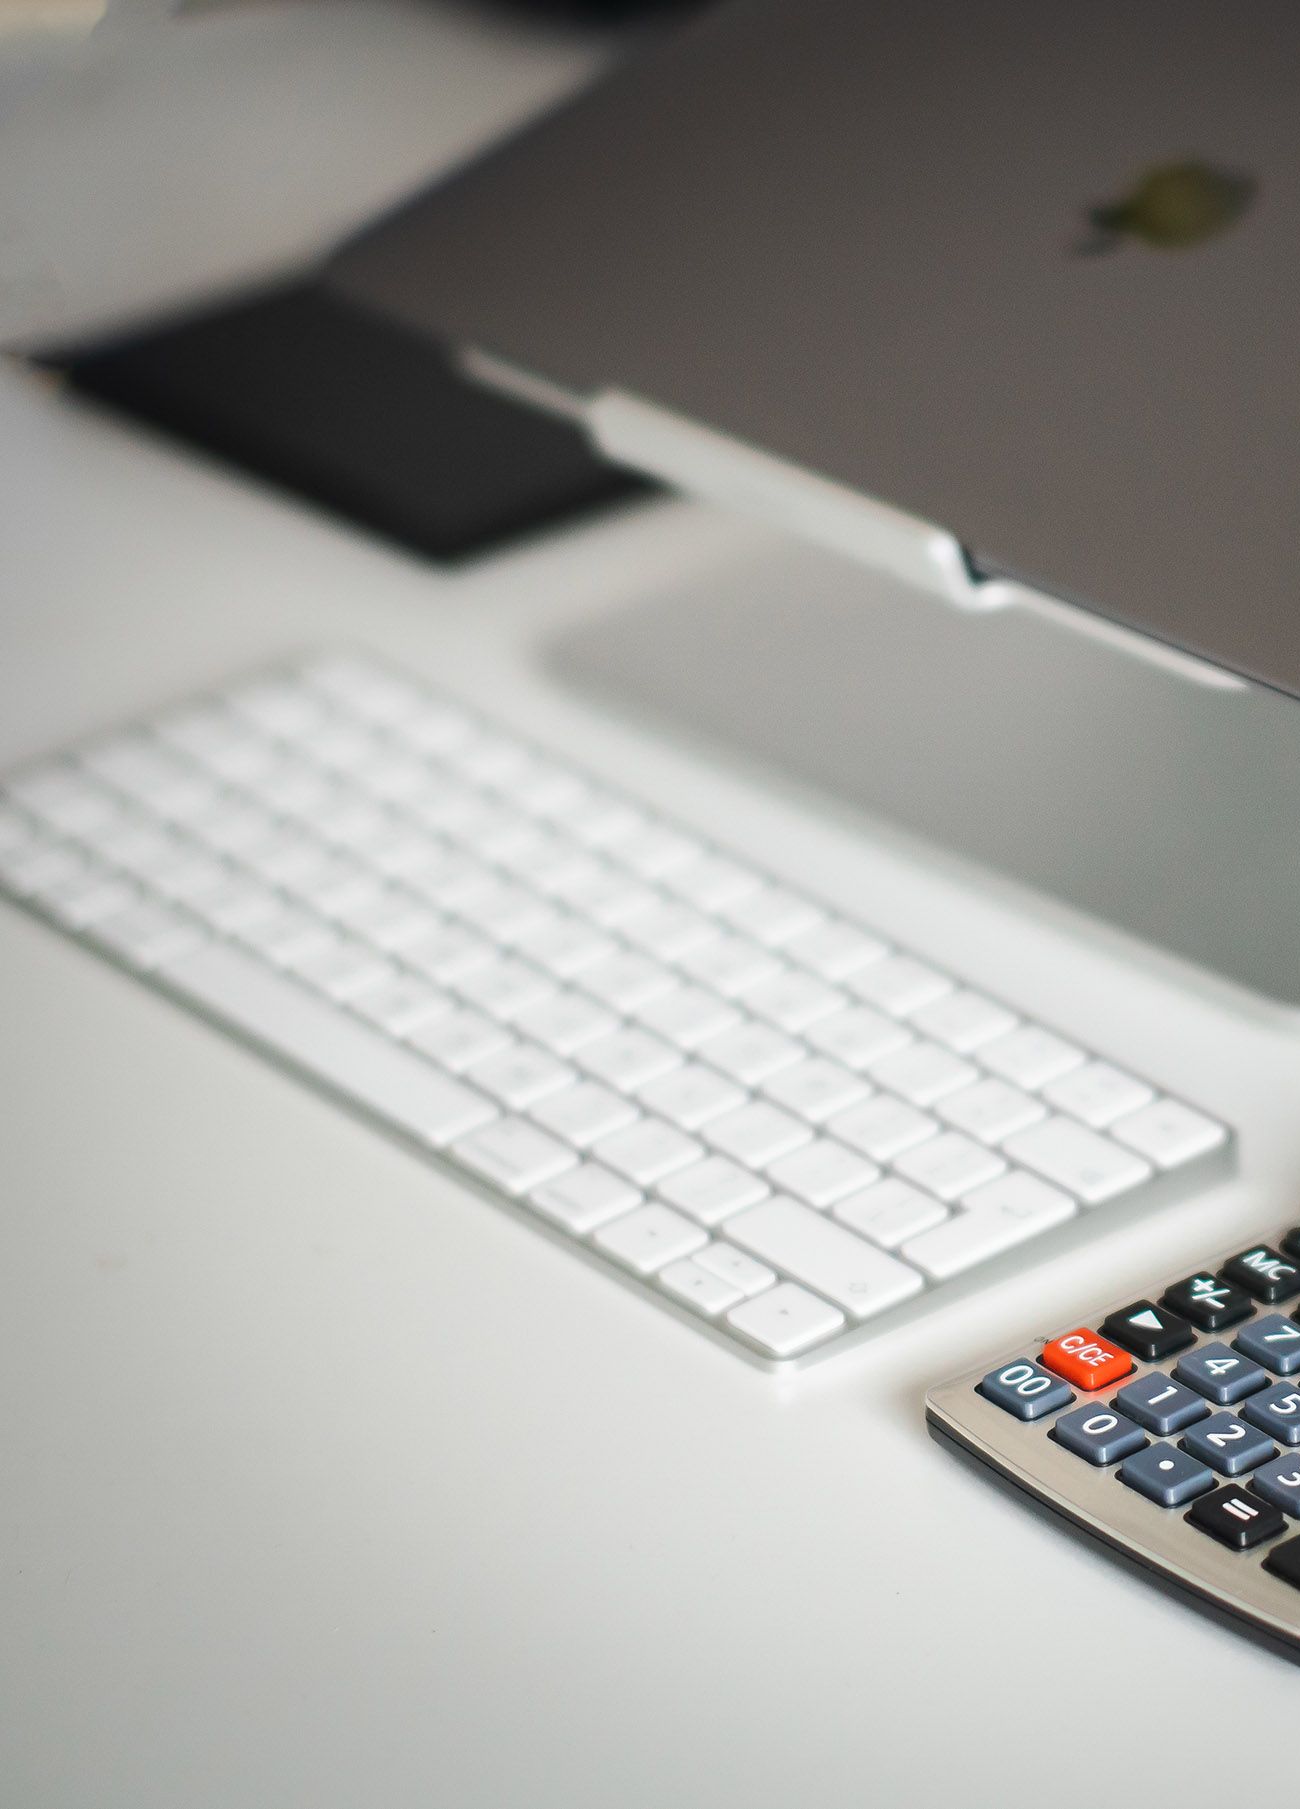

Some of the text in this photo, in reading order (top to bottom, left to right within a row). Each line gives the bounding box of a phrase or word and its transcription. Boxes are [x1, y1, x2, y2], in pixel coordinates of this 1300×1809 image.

[1243, 1250, 1297, 1282] MC
[1264, 1326, 1300, 1341] 7
[1059, 1335, 1113, 1367] C/CE
[1205, 1359, 1239, 1375] 4
[1148, 1386, 1177, 1404] 1
[1082, 1415, 1117, 1434] 0
[1207, 1425, 1245, 1446] 2
